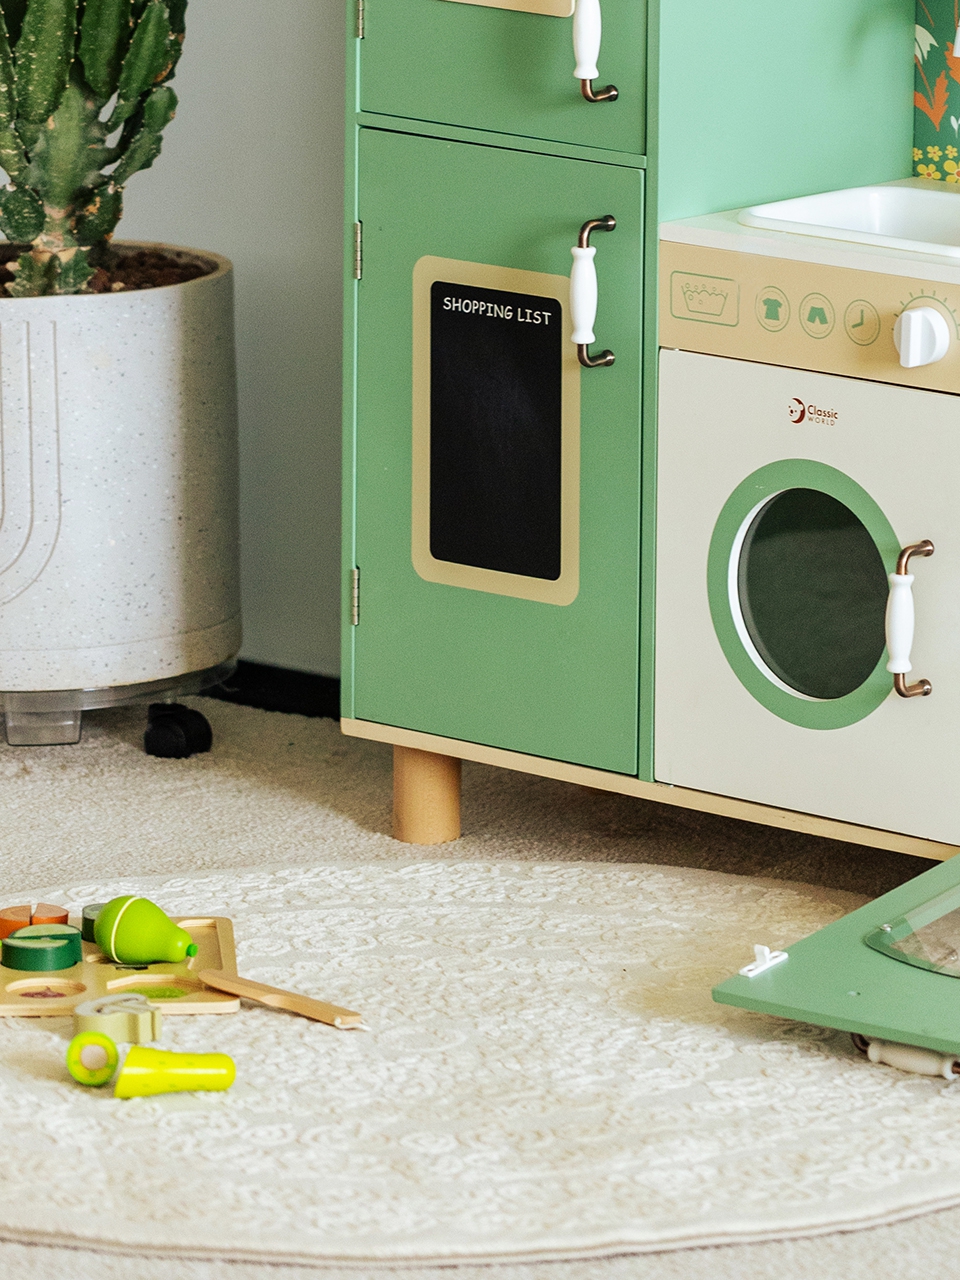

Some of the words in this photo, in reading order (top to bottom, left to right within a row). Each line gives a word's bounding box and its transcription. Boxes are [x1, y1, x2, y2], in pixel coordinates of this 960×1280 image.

[443, 297, 513, 319] SHOPPING
[518, 308, 551, 325] LIST
[808, 405, 838, 419] Classic
[808, 416, 835, 426] WORLD
